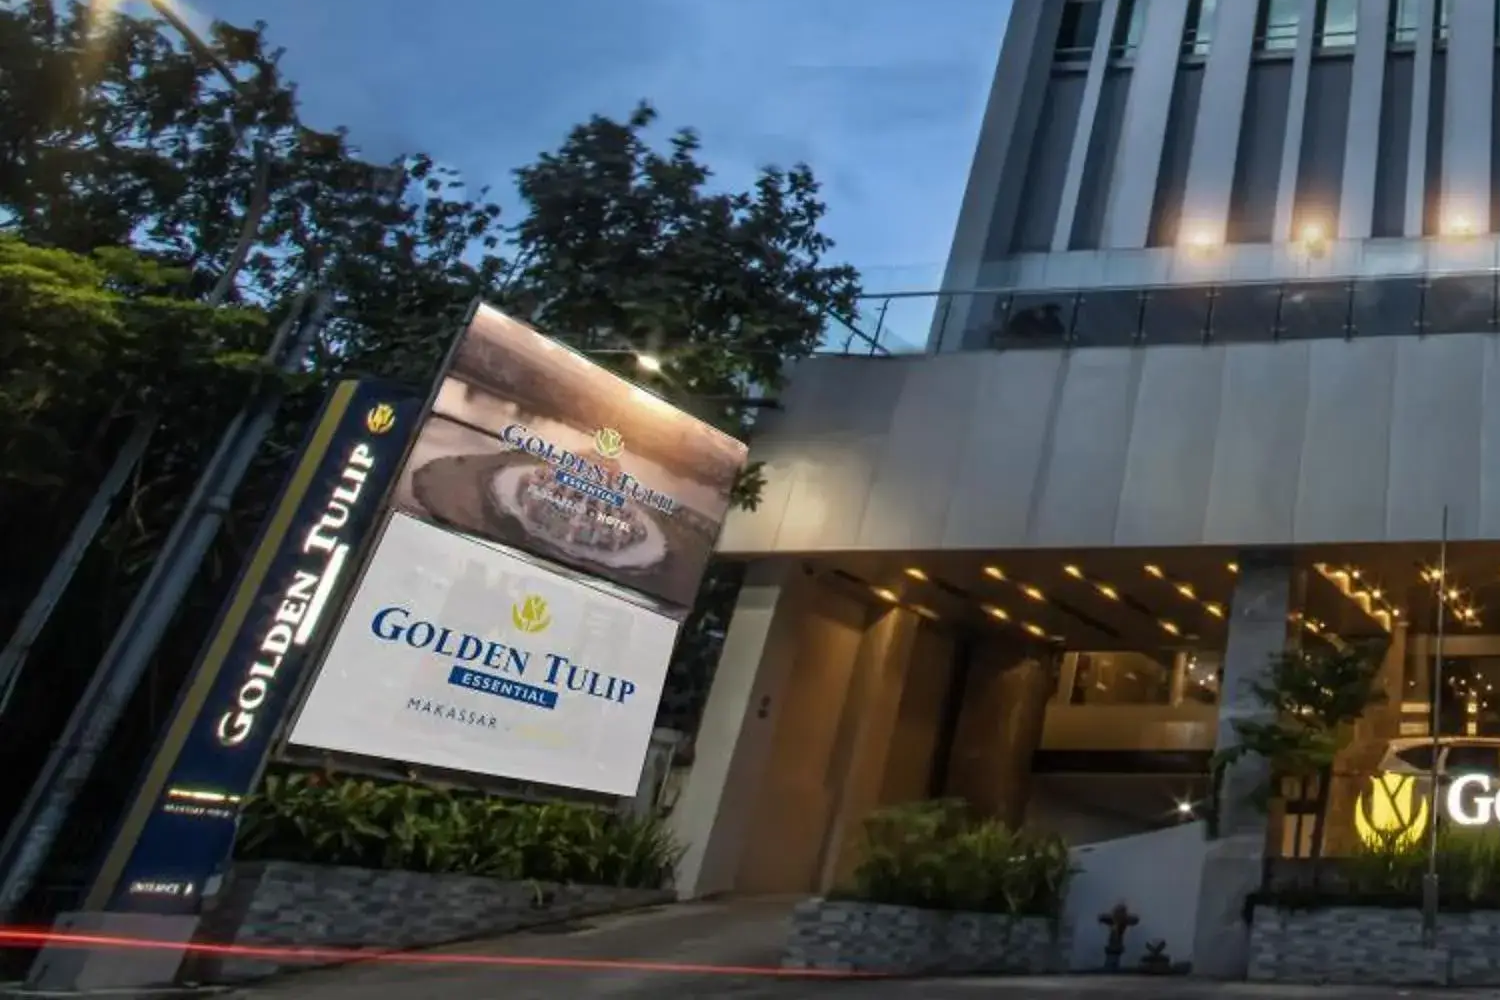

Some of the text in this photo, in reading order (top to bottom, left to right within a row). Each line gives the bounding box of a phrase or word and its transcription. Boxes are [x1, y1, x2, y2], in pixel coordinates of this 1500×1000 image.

[217, 442, 376, 746] GOLDEN TULIP
[371, 606, 635, 704] GOLDEN TULIP
[407, 697, 499, 729] MAKASSAR
[462, 673, 547, 706] ESSENTIAL
